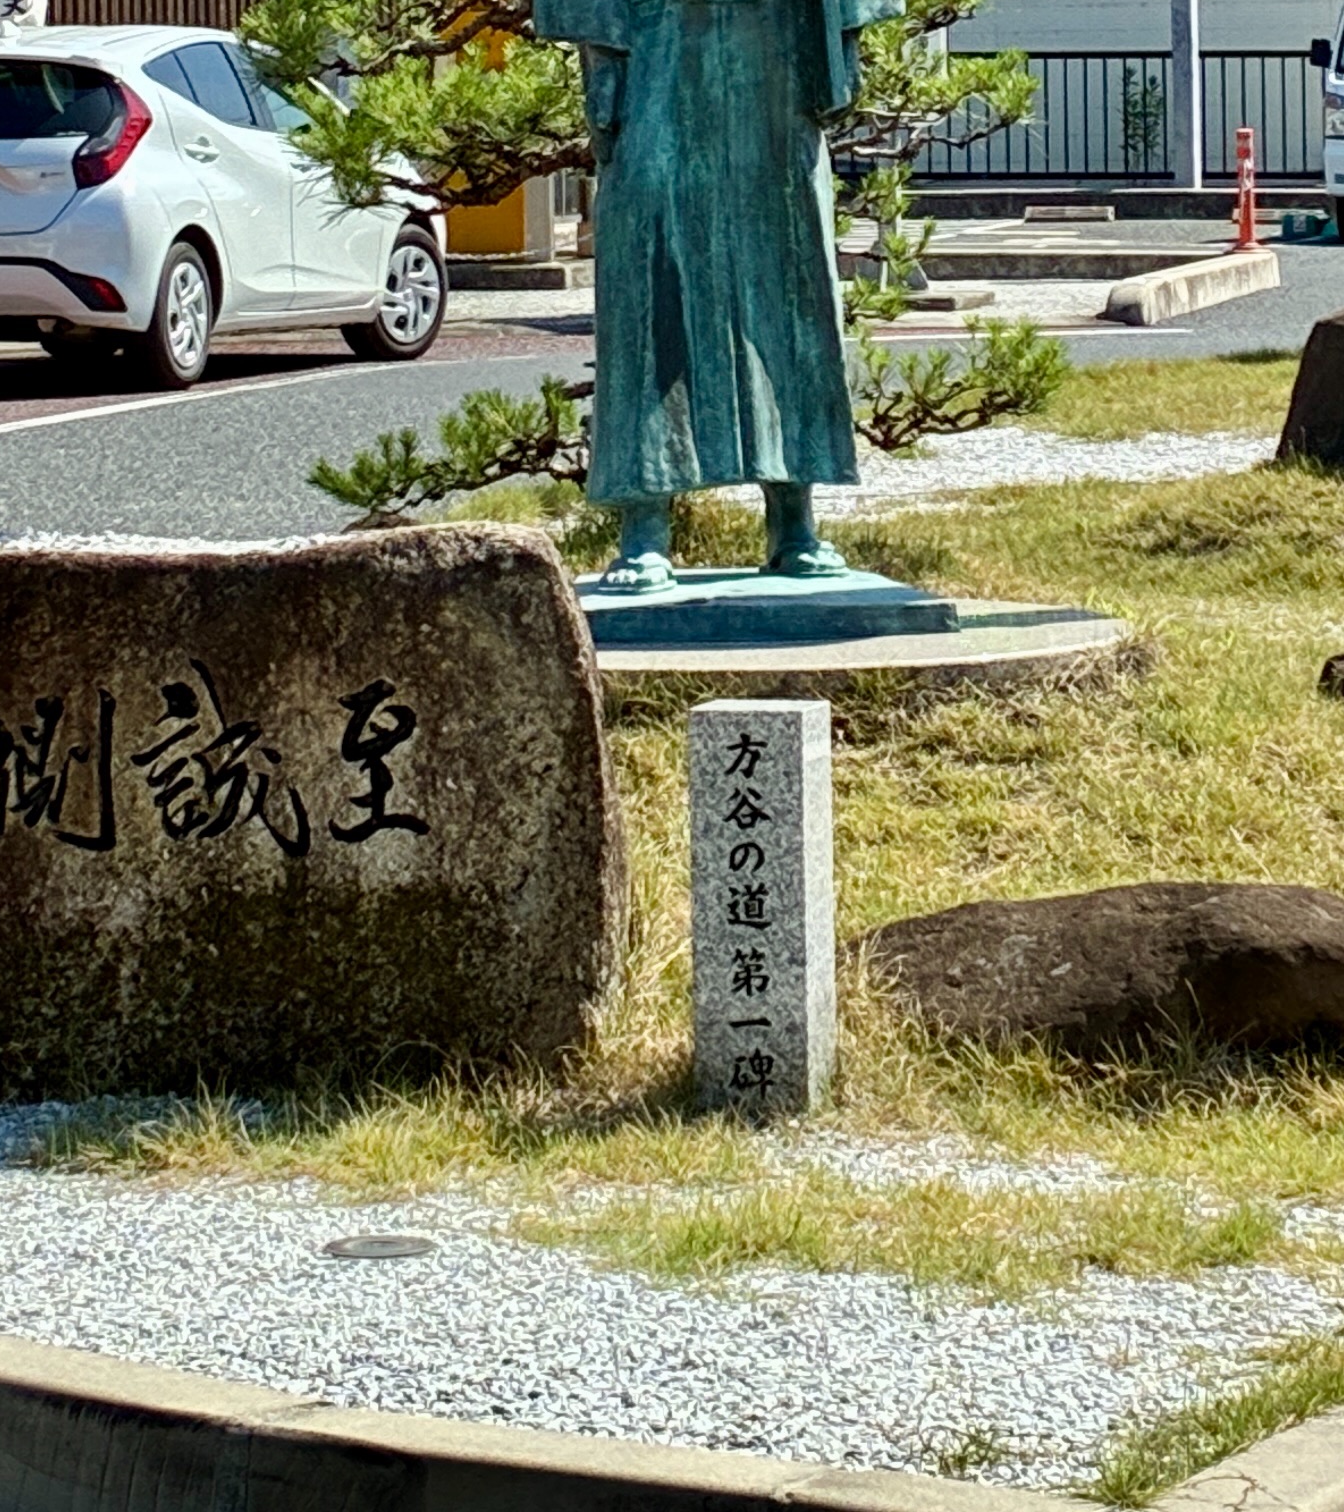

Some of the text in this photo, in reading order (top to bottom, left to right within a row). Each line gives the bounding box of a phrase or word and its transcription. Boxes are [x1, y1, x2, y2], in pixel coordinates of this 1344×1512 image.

[723, 733, 775, 1100] 方谷の道第一碑
